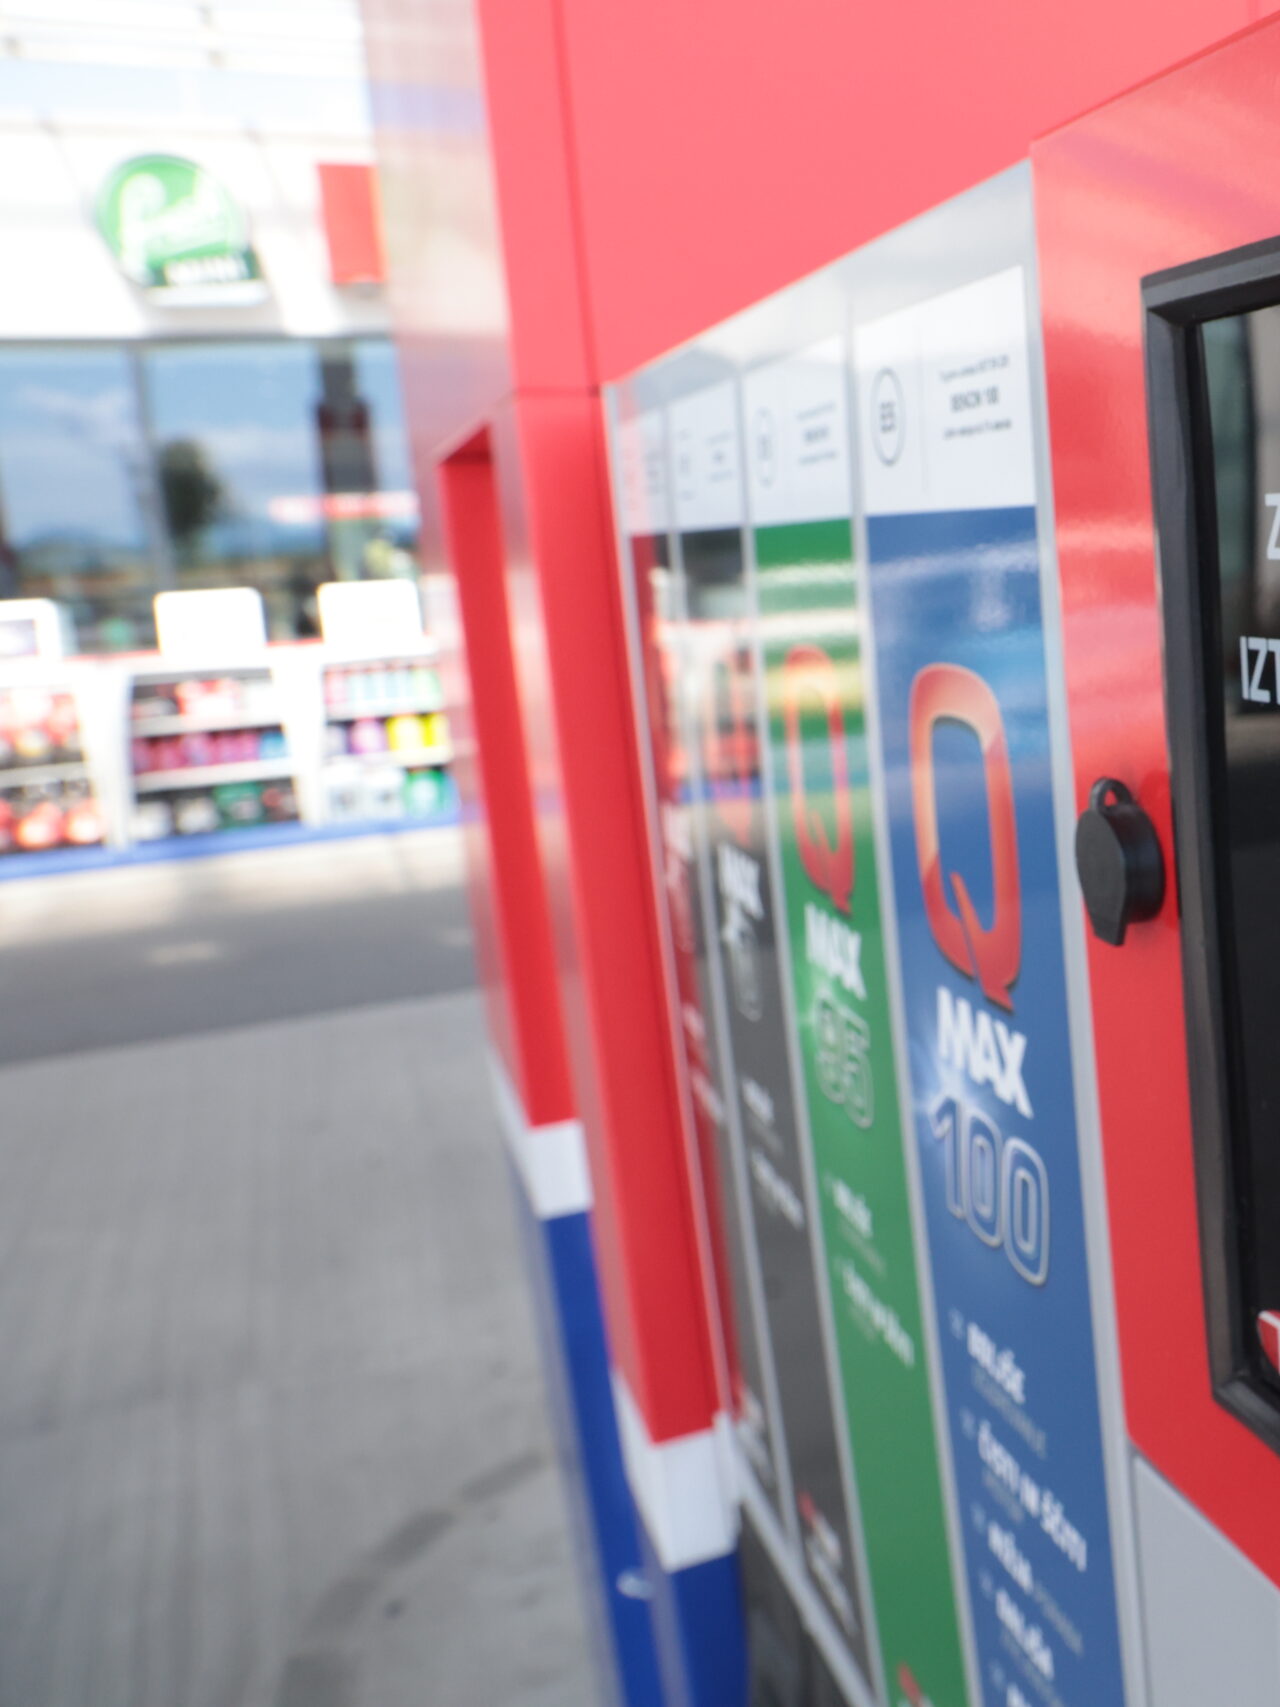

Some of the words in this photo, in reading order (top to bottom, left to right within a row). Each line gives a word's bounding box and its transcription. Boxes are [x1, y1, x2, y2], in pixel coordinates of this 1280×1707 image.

[908, 661, 1023, 1014] Q
[936, 986, 1035, 1120] MAX
[930, 1092, 1050, 1288] 100
